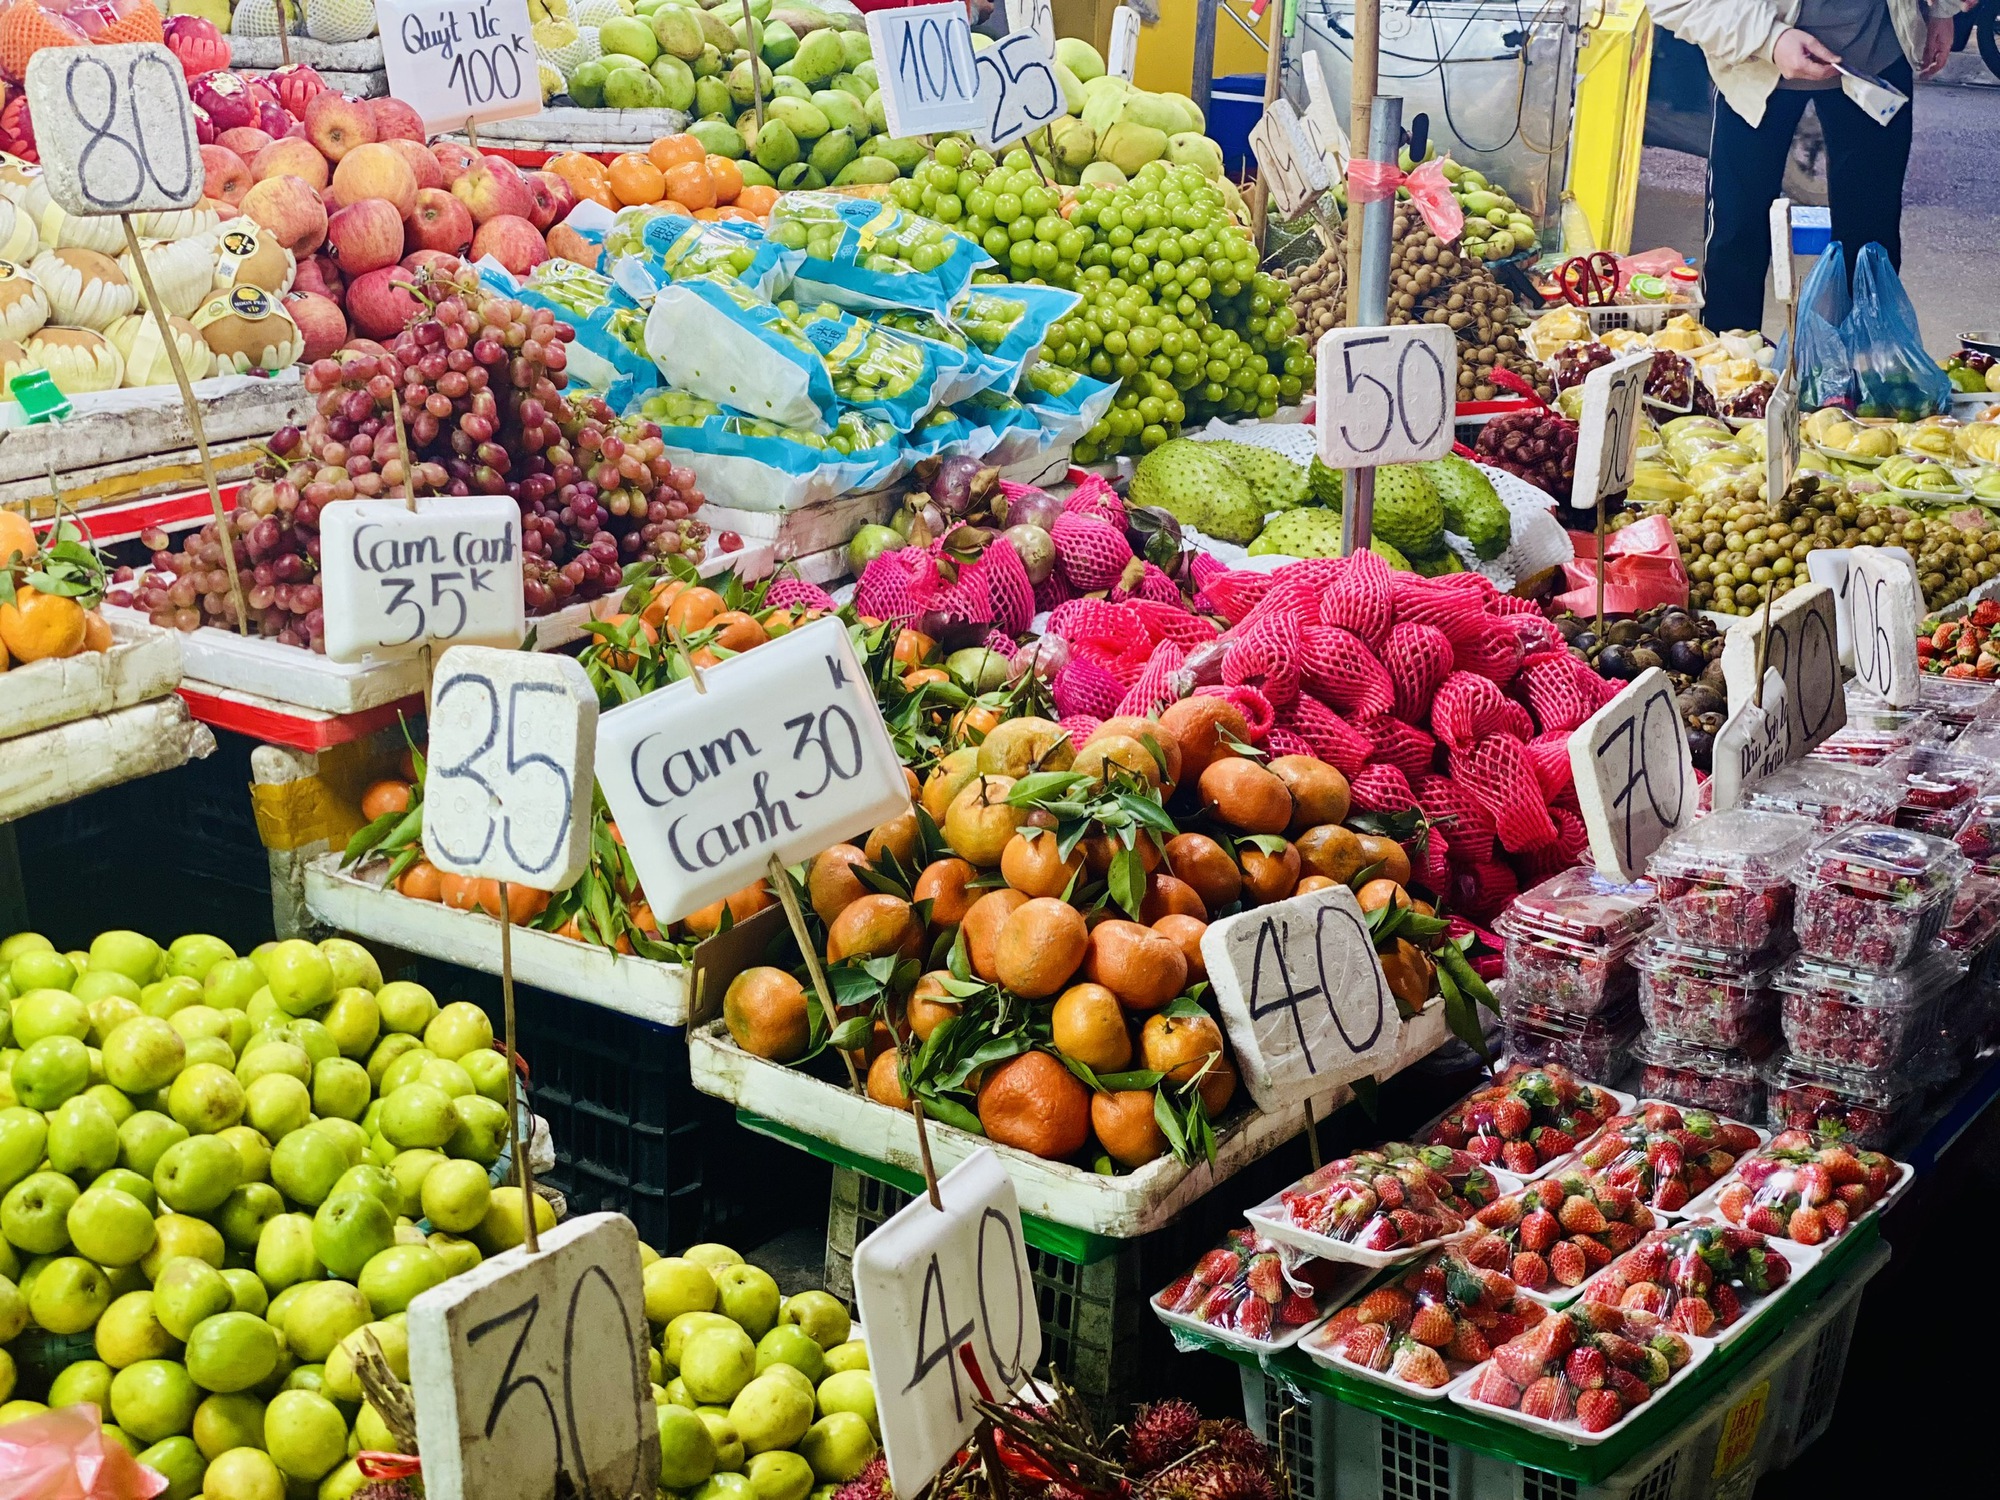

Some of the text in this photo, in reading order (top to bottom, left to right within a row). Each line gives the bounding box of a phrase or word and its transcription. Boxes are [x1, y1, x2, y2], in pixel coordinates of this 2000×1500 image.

[899, 17, 980, 103] 100
[975, 34, 1059, 144] 25
[66, 51, 193, 208] 80
[896, 217, 927, 247] Grape
[1340, 335, 1447, 453] 50
[353, 522, 447, 573] Cam
[430, 672, 573, 876] 35
[631, 727, 763, 808] Cam
[667, 770, 803, 873] Canh
[1597, 689, 1684, 870] 70
[1250, 905, 1384, 1075] 40
[901, 1205, 1024, 1424] 40
[466, 1264, 643, 1499] 30
